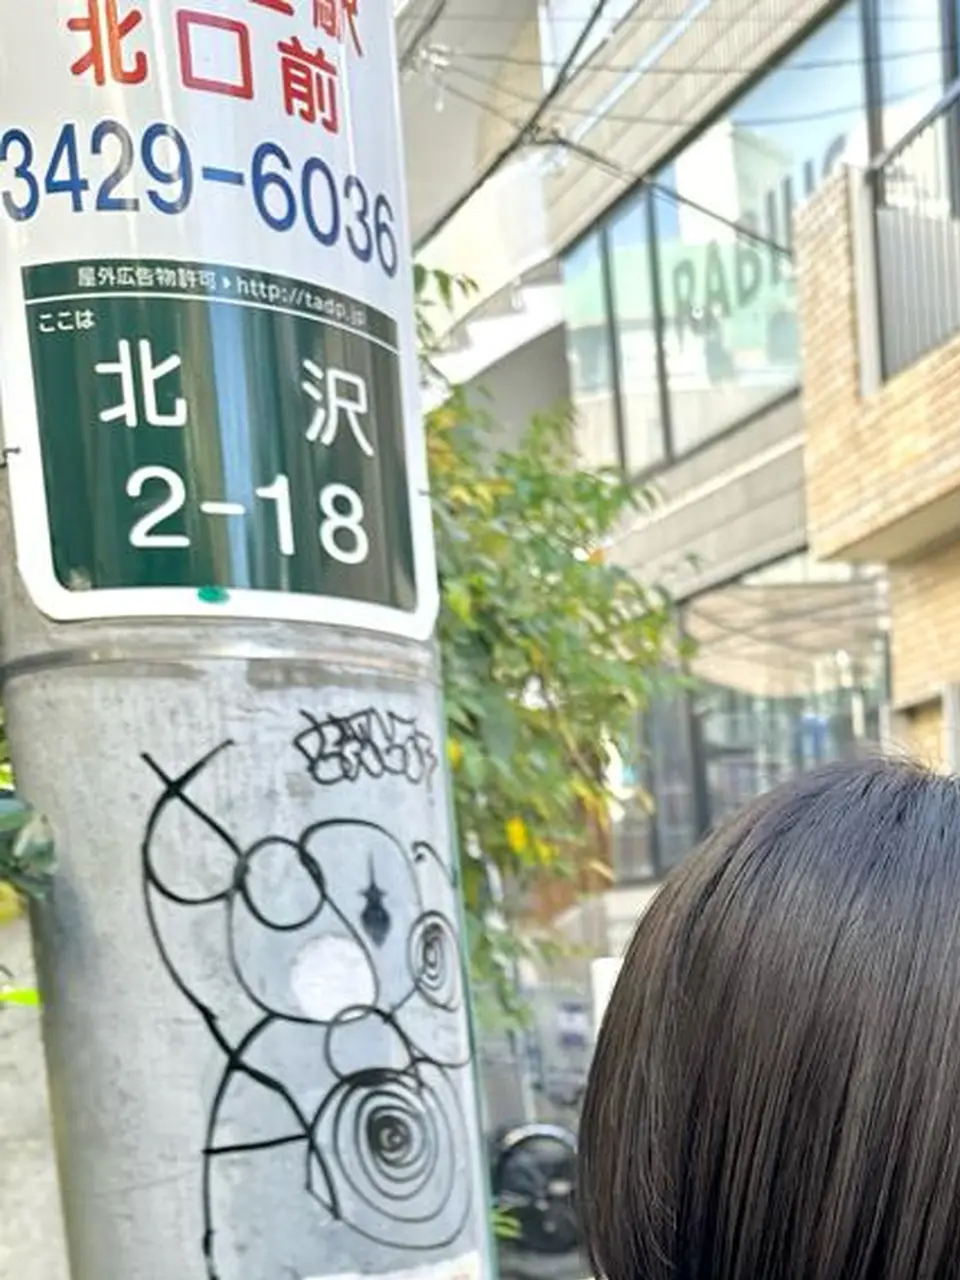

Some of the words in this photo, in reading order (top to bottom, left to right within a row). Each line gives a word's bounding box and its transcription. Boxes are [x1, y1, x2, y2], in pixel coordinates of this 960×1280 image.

[67, 0, 338, 134] 北口前
[0, 120, 398, 278] 3429-6036
[38, 309, 96, 333] ここは
[77, 265, 217, 290] 屋外広告物許可
[95, 338, 374, 457] 北沢
[126, 465, 369, 565] 2-18
